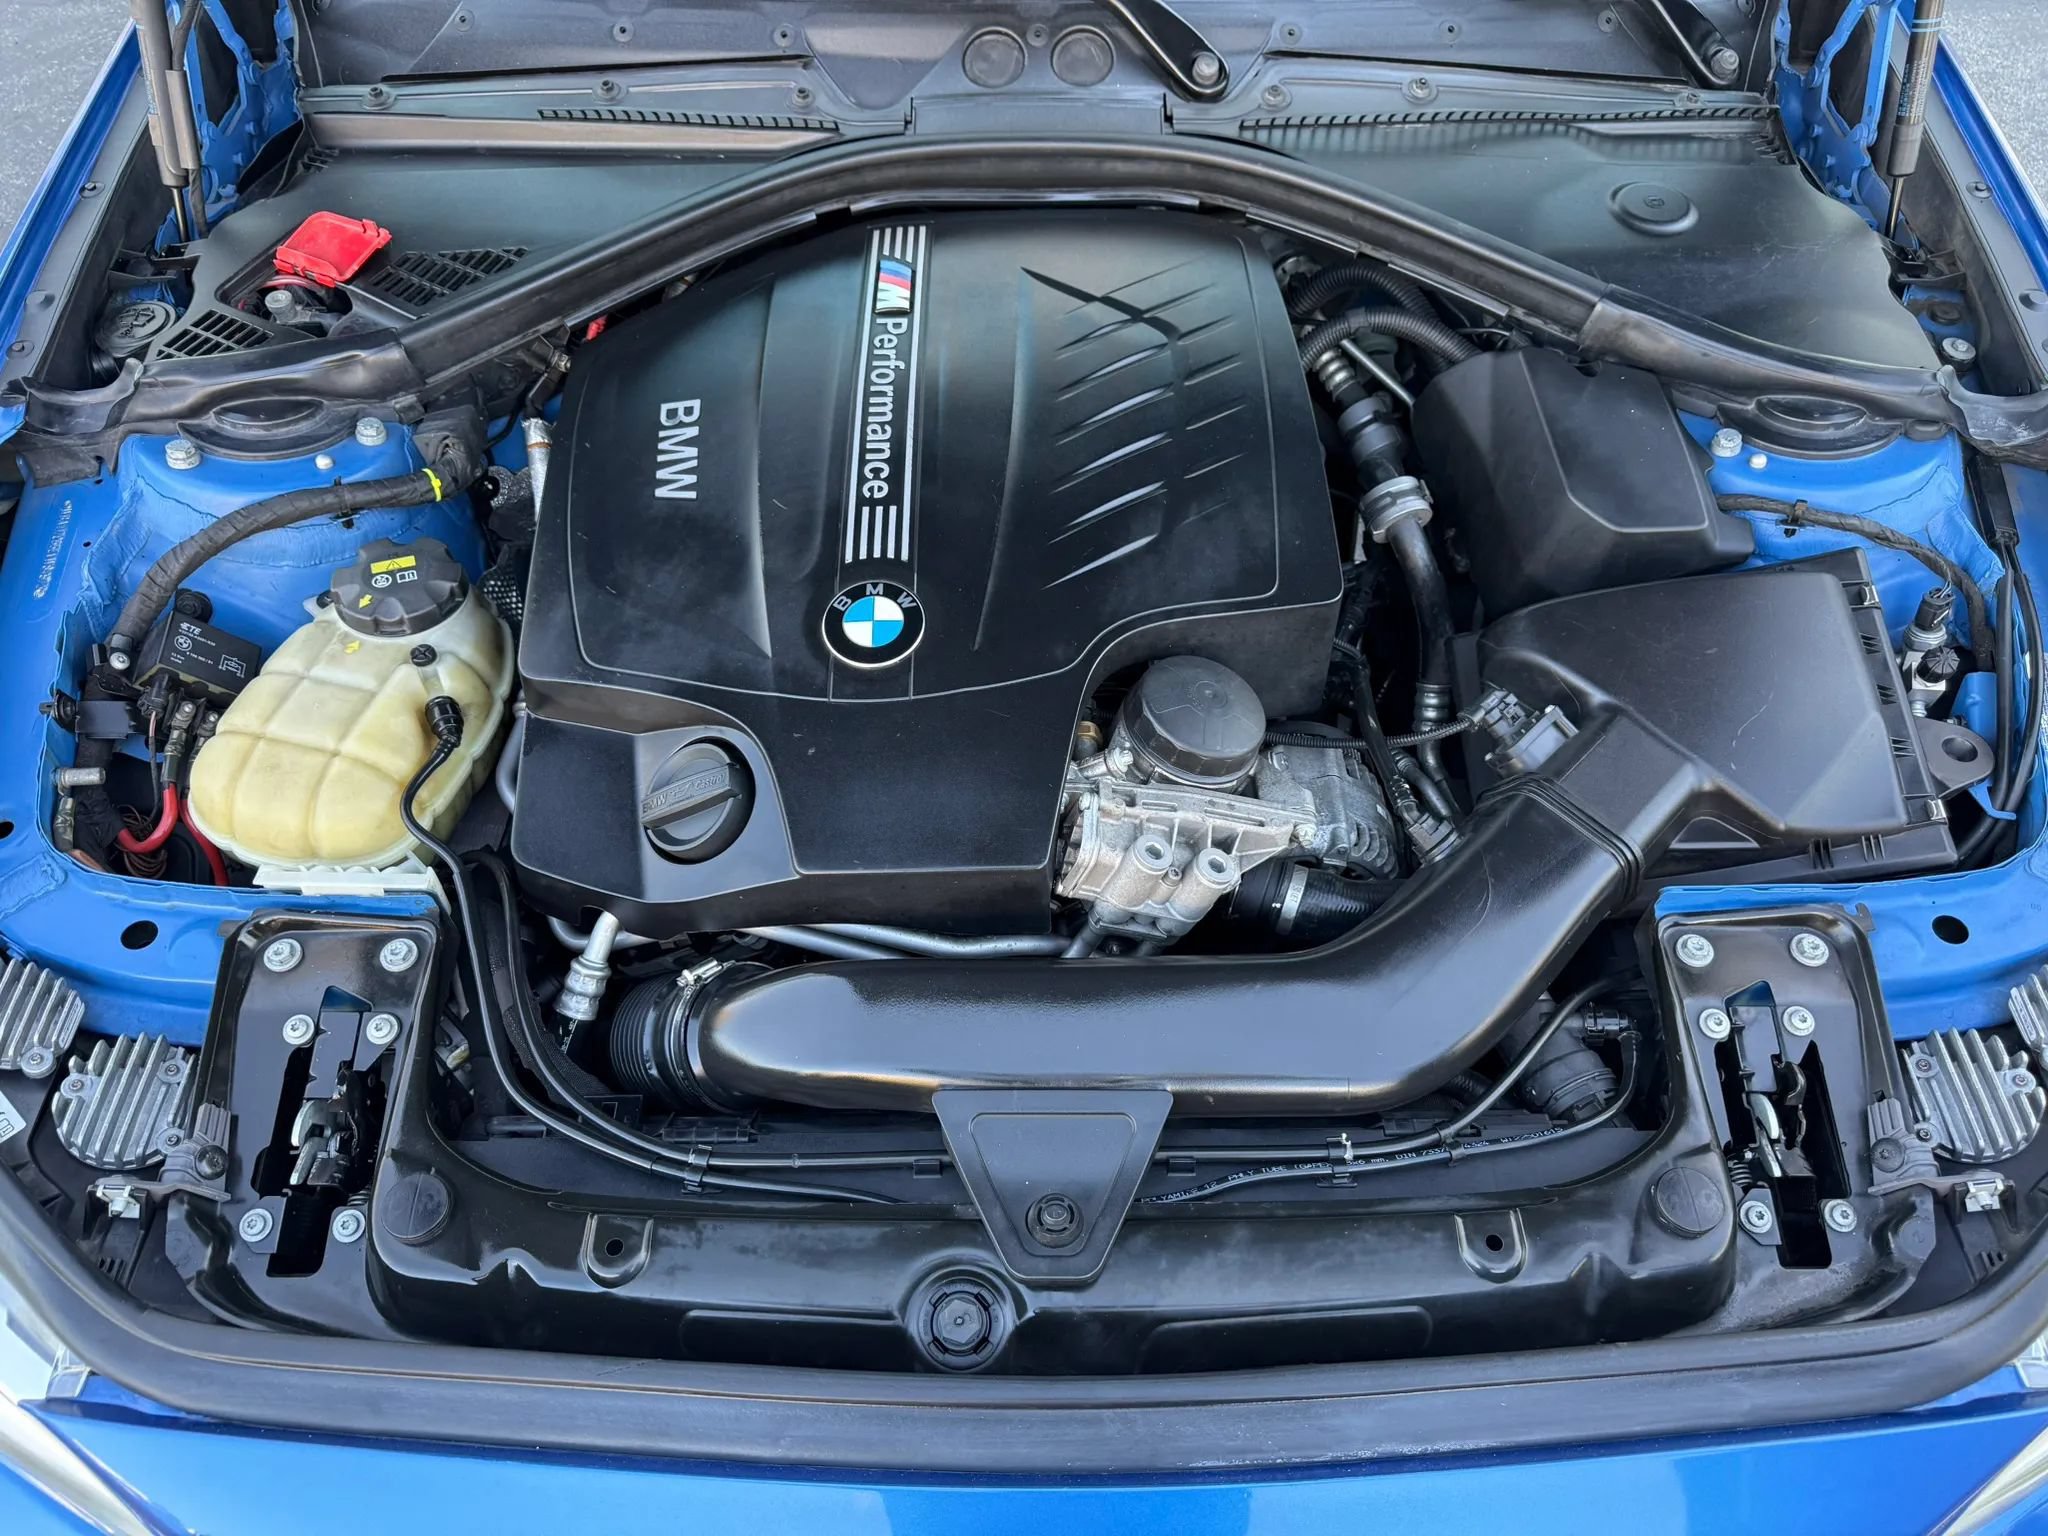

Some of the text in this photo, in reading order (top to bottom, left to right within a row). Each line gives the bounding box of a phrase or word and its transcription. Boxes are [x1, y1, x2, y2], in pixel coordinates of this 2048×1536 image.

[861, 317, 909, 499] Performance
[654, 398, 701, 499] BMW
[832, 582, 918, 612] BMW
[642, 792, 669, 814] BMW
[1395, 1151, 1417, 1161] DIN
